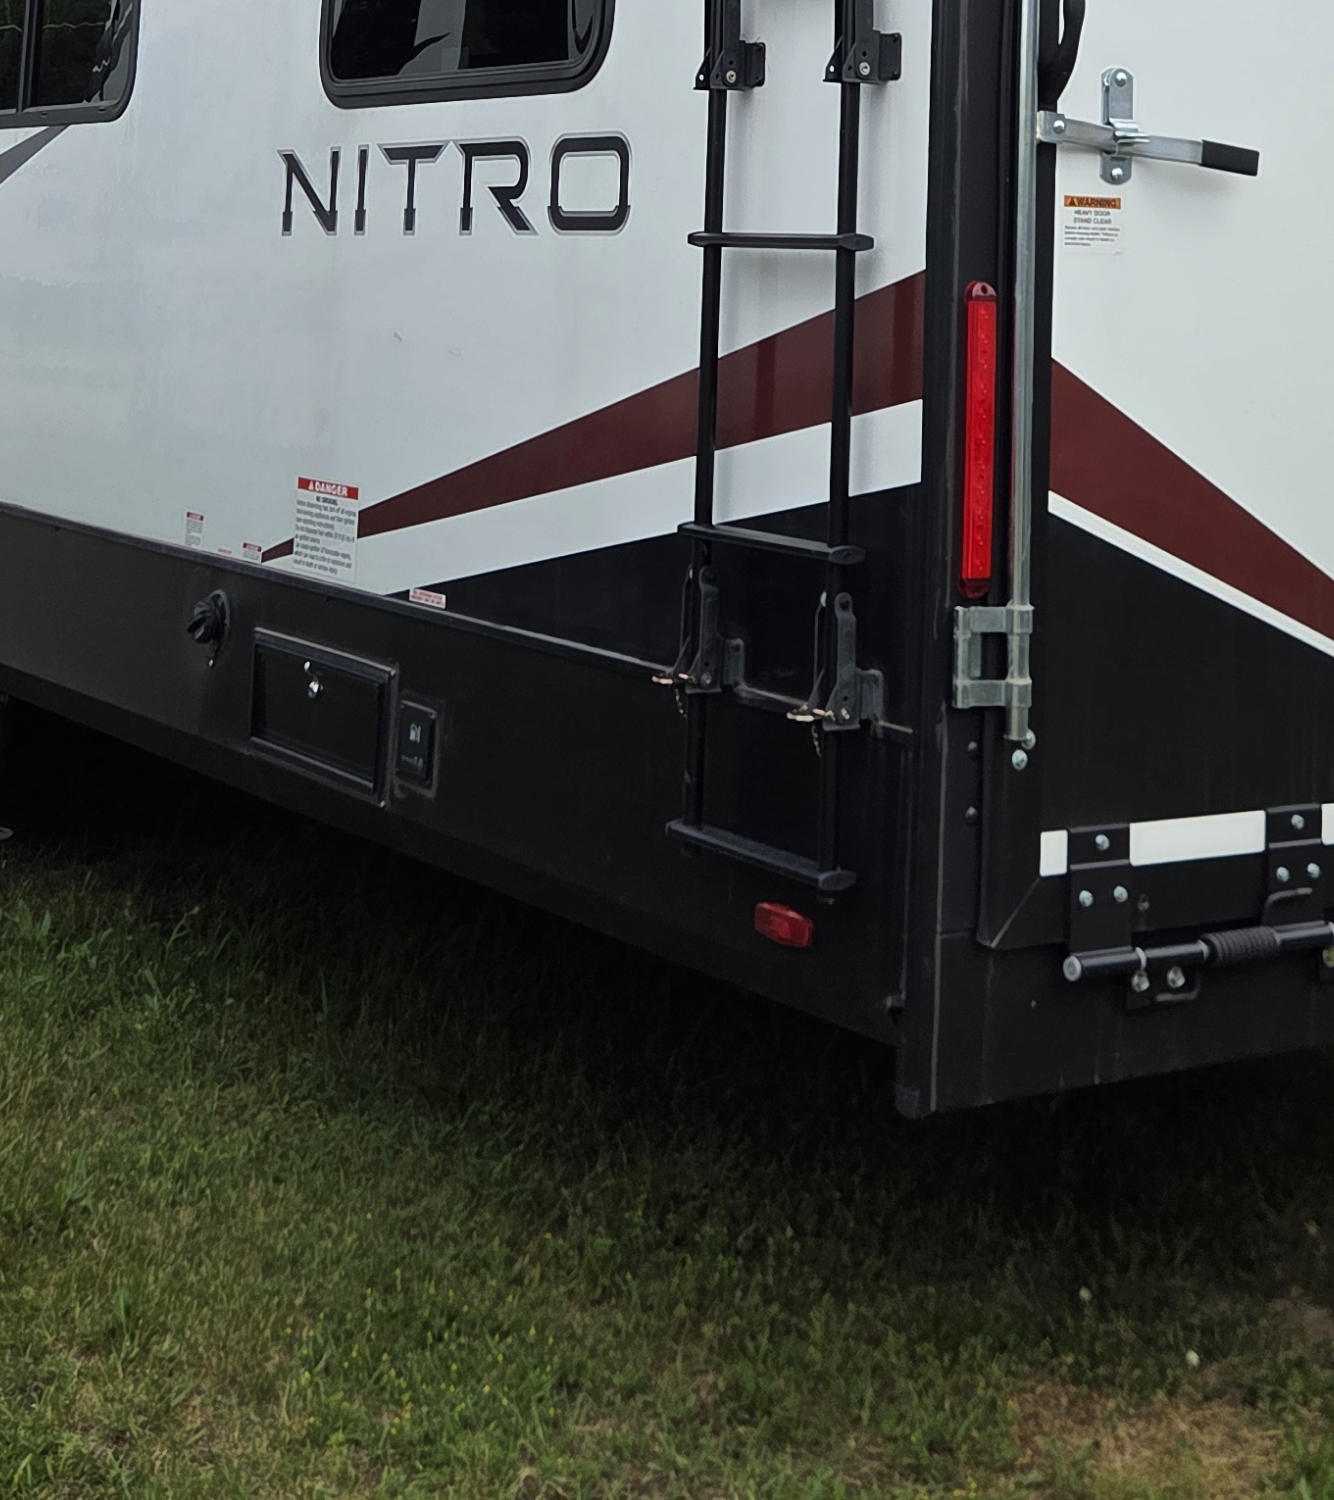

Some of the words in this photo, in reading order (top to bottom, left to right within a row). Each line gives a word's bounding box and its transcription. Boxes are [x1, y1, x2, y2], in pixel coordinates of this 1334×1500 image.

[277, 129, 633, 237] NITRO
[1077, 196, 1117, 209] WARNING
[314, 481, 348, 497] DANGER
